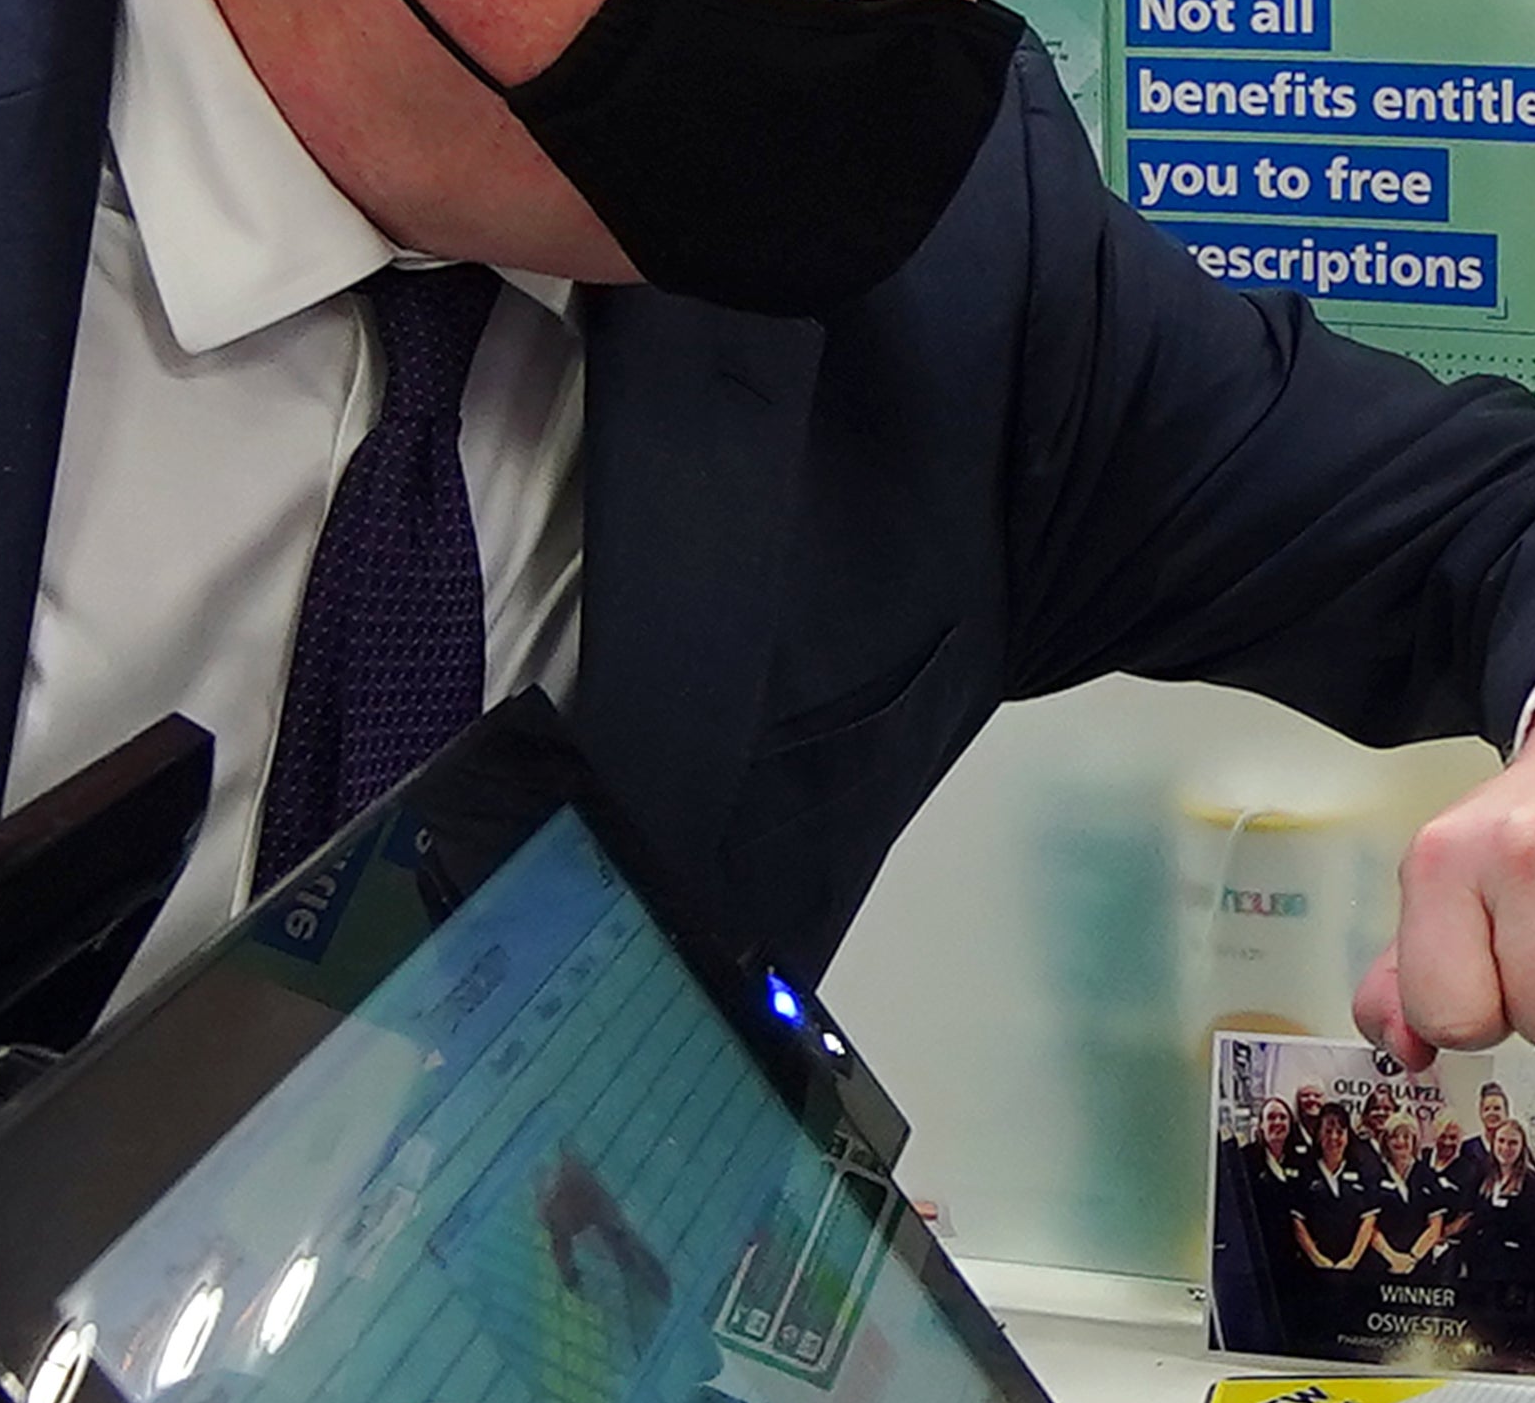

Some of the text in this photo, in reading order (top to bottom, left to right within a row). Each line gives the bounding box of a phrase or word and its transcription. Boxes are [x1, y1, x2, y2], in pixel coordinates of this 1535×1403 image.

[1138, 70, 1356, 119] benefits
[1139, 156, 1431, 207] you to free
[1334, 1079, 1371, 1096] OLD
[1380, 1284, 1455, 1306] WINNER
[1367, 1313, 1469, 1336] OSWESTRY
